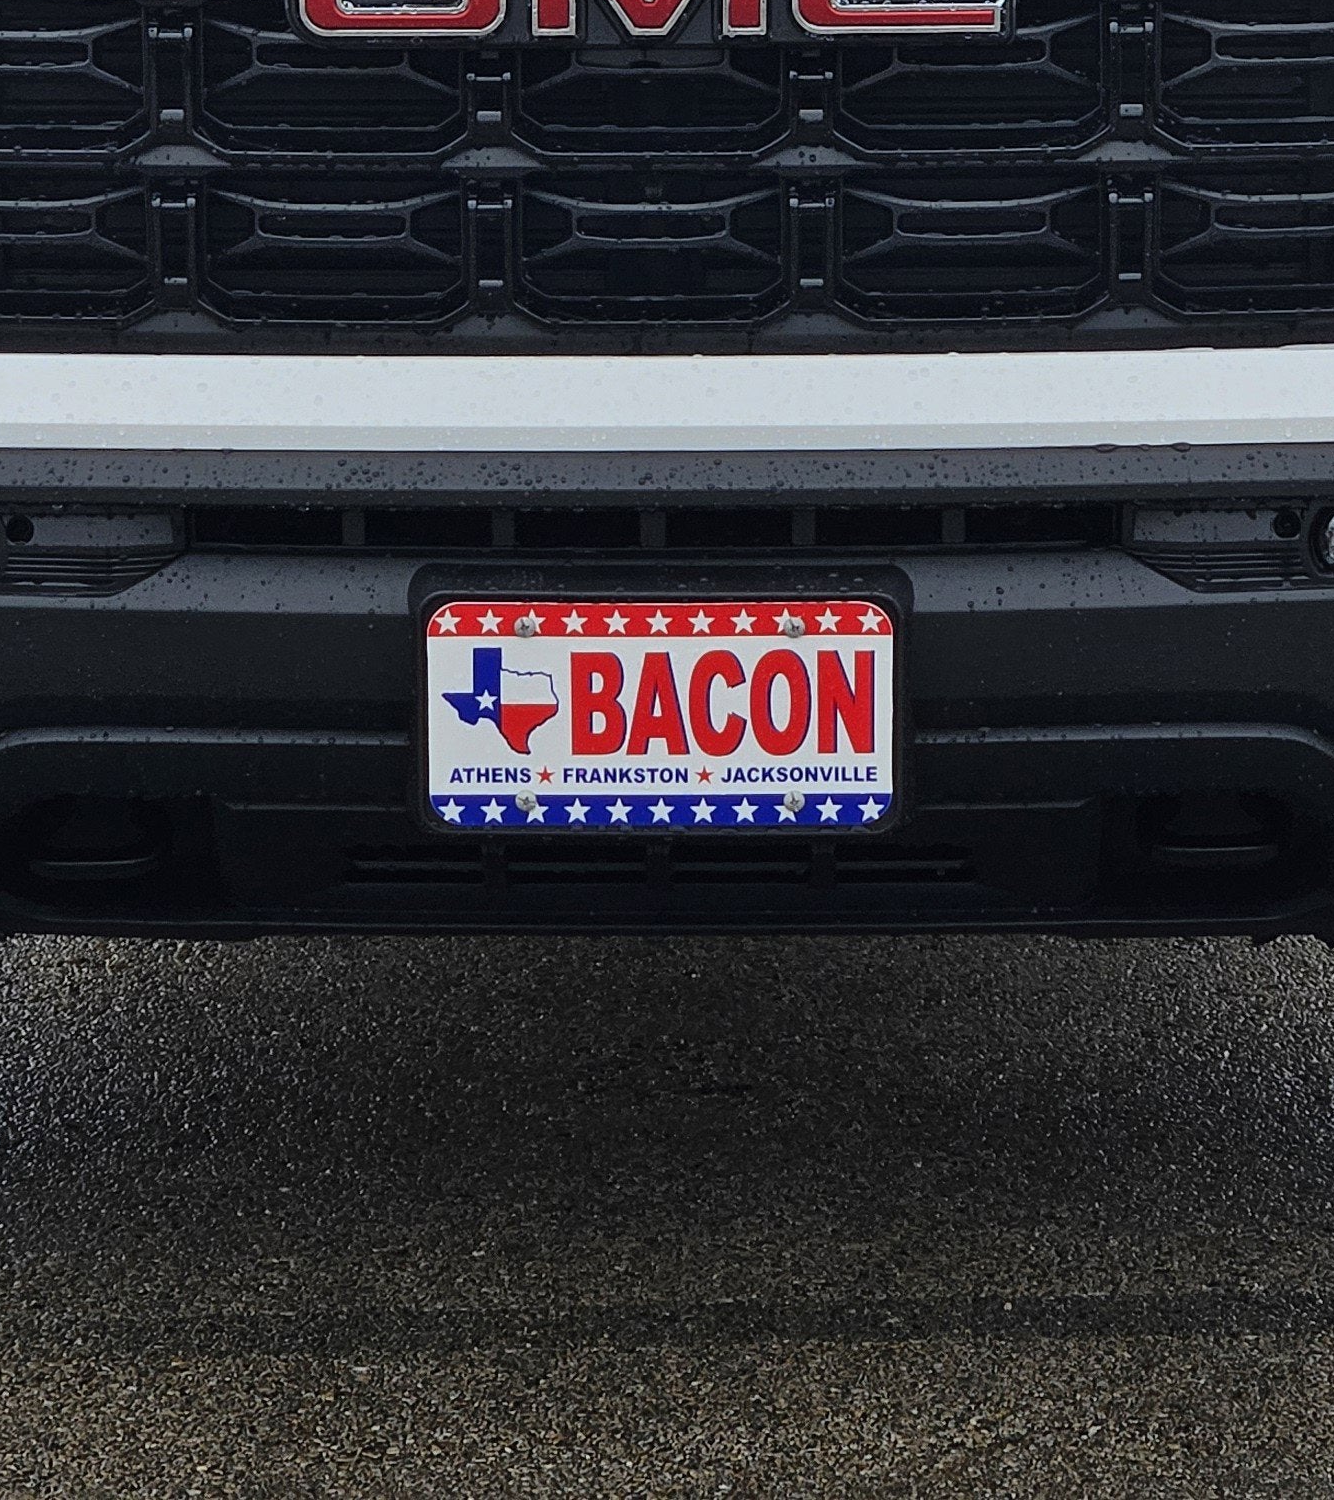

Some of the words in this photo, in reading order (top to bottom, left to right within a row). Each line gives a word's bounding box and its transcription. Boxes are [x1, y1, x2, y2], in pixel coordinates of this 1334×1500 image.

[570, 649, 877, 757] BACON
[449, 767, 533, 784] ATHENS
[562, 767, 689, 784] FRANKSTON
[720, 766, 878, 783] JACKSONVILLE
